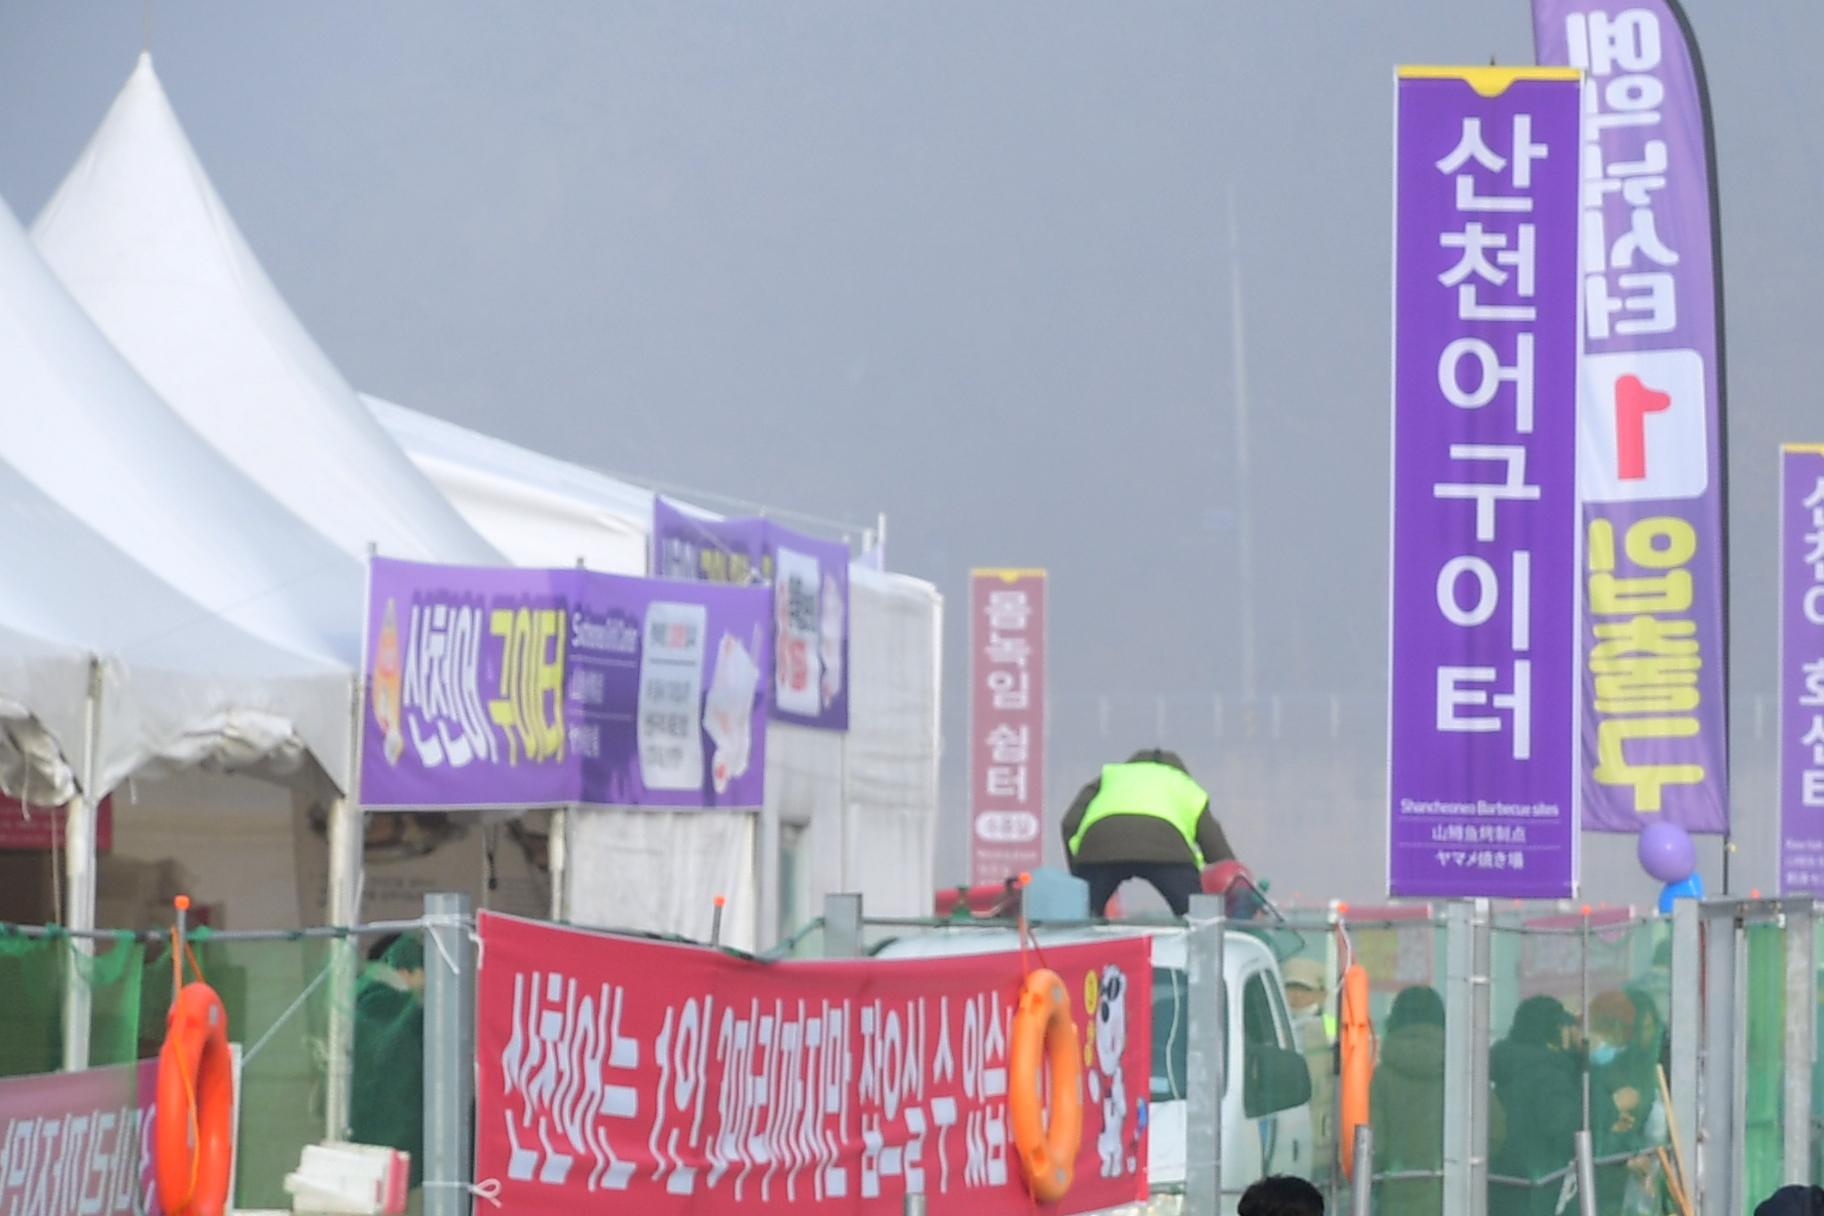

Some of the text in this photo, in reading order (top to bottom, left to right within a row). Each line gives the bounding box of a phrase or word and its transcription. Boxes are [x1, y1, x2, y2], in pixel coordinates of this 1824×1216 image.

[1433, 113, 1548, 761] 산천어구이터
[403, 604, 498, 769] 산천어
[984, 723, 1031, 803] 쉼터
[502, 971, 639, 1192] 산천어는
[650, 993, 713, 1196] 1인
[858, 996, 927, 1199] 잡으실
[931, 994, 958, 1195] 수
